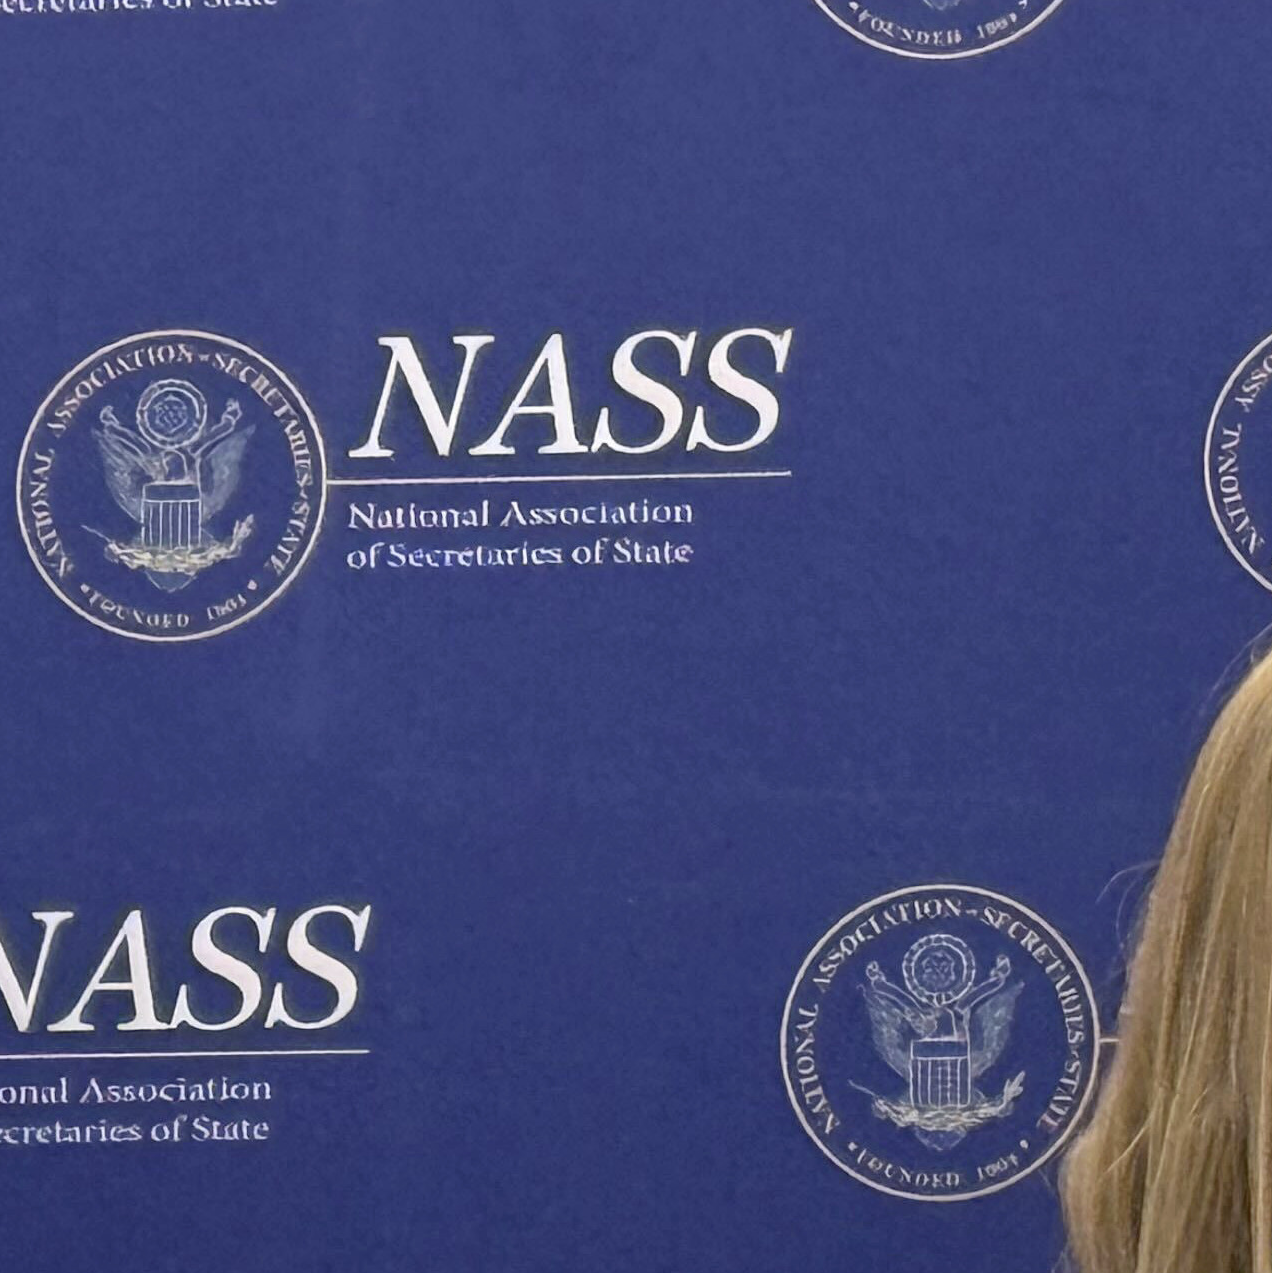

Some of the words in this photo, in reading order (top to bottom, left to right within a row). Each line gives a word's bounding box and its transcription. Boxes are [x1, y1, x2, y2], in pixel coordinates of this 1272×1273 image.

[349, 328, 792, 457] NASS
[349, 500, 488, 528] National
[500, 499, 692, 526] Association
[347, 542, 384, 569] of
[388, 542, 563, 567] Secretaries
[572, 540, 604, 564] of
[614, 538, 693, 564] State
[80, 1077, 271, 1103] Association
[151, 1115, 187, 1141] of
[192, 1116, 269, 1141] State
